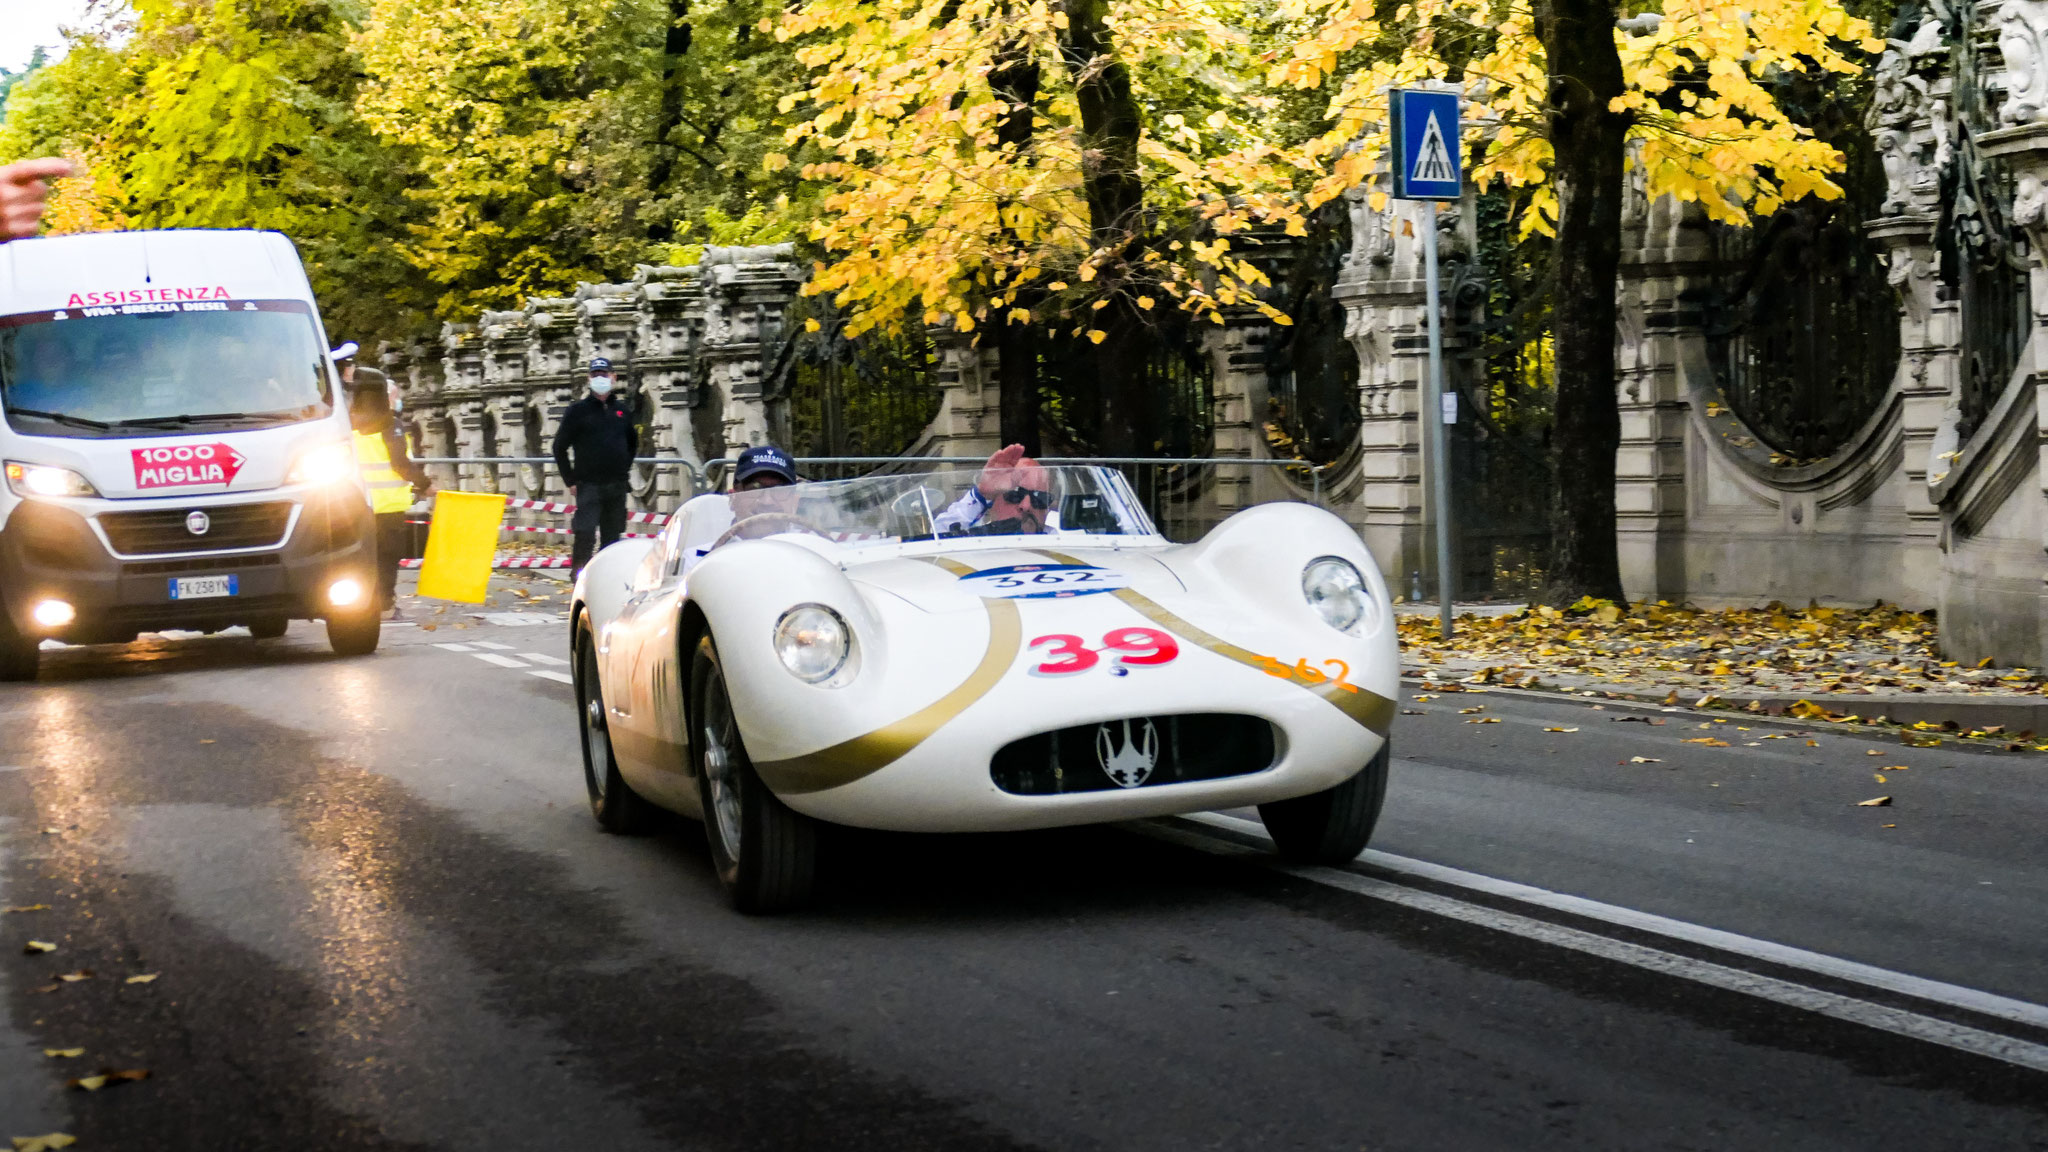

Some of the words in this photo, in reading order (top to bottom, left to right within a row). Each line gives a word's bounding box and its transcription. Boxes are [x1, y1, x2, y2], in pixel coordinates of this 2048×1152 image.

[68, 286, 231, 307] ASSISTENZA
[182, 302, 229, 312] DIESEL
[141, 446, 215, 463] 1000
[140, 464, 224, 485] MIGLIA
[1028, 627, 1180, 676] 39
[1251, 655, 1358, 694] 362
